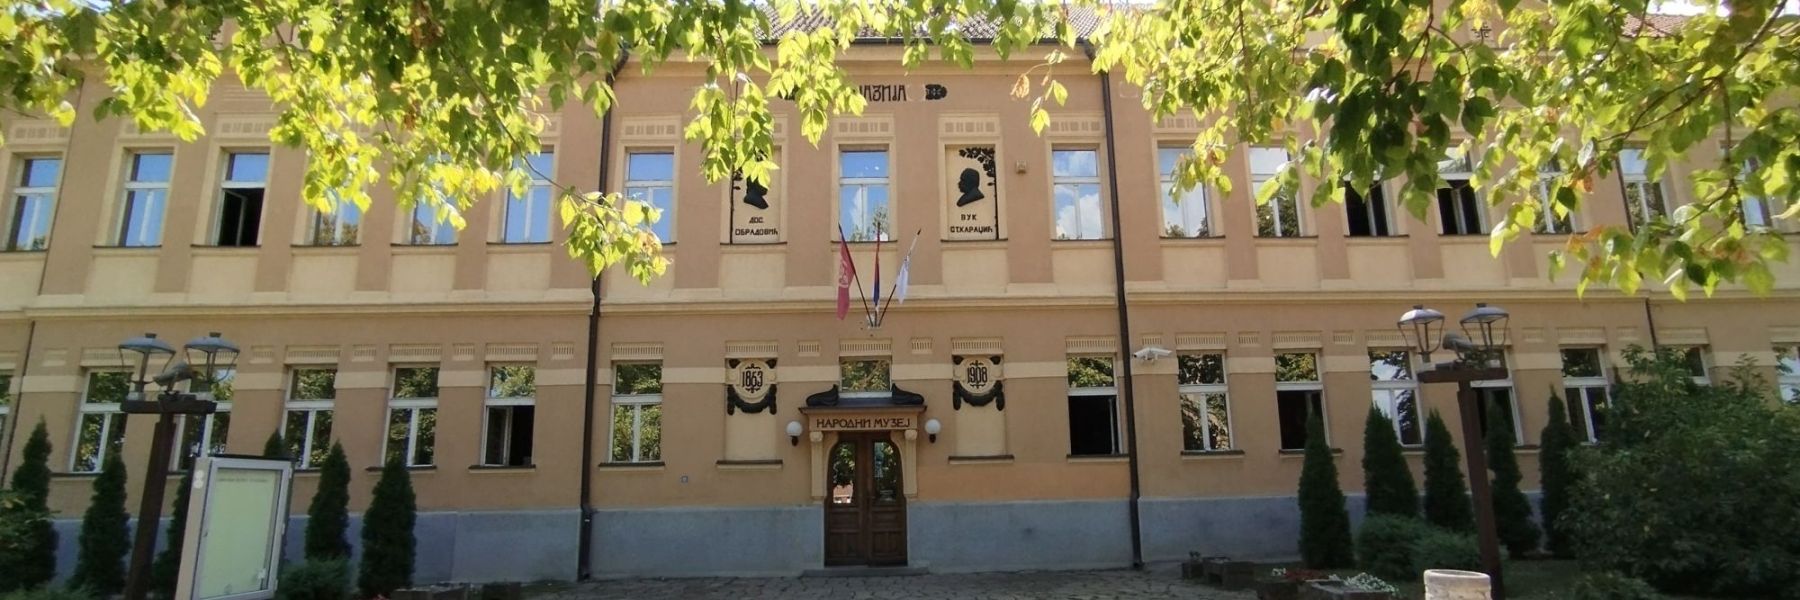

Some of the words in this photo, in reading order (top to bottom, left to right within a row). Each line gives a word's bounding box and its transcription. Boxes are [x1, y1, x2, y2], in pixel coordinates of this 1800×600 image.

[960, 213, 977, 221] ВУК
[735, 228, 779, 236] ОБРАДОВИЋ
[742, 370, 763, 388] 1863
[967, 366, 988, 384] 1908
[816, 418, 871, 428] НАРОДНИ
[873, 418, 910, 428] МУЗЕЈ
